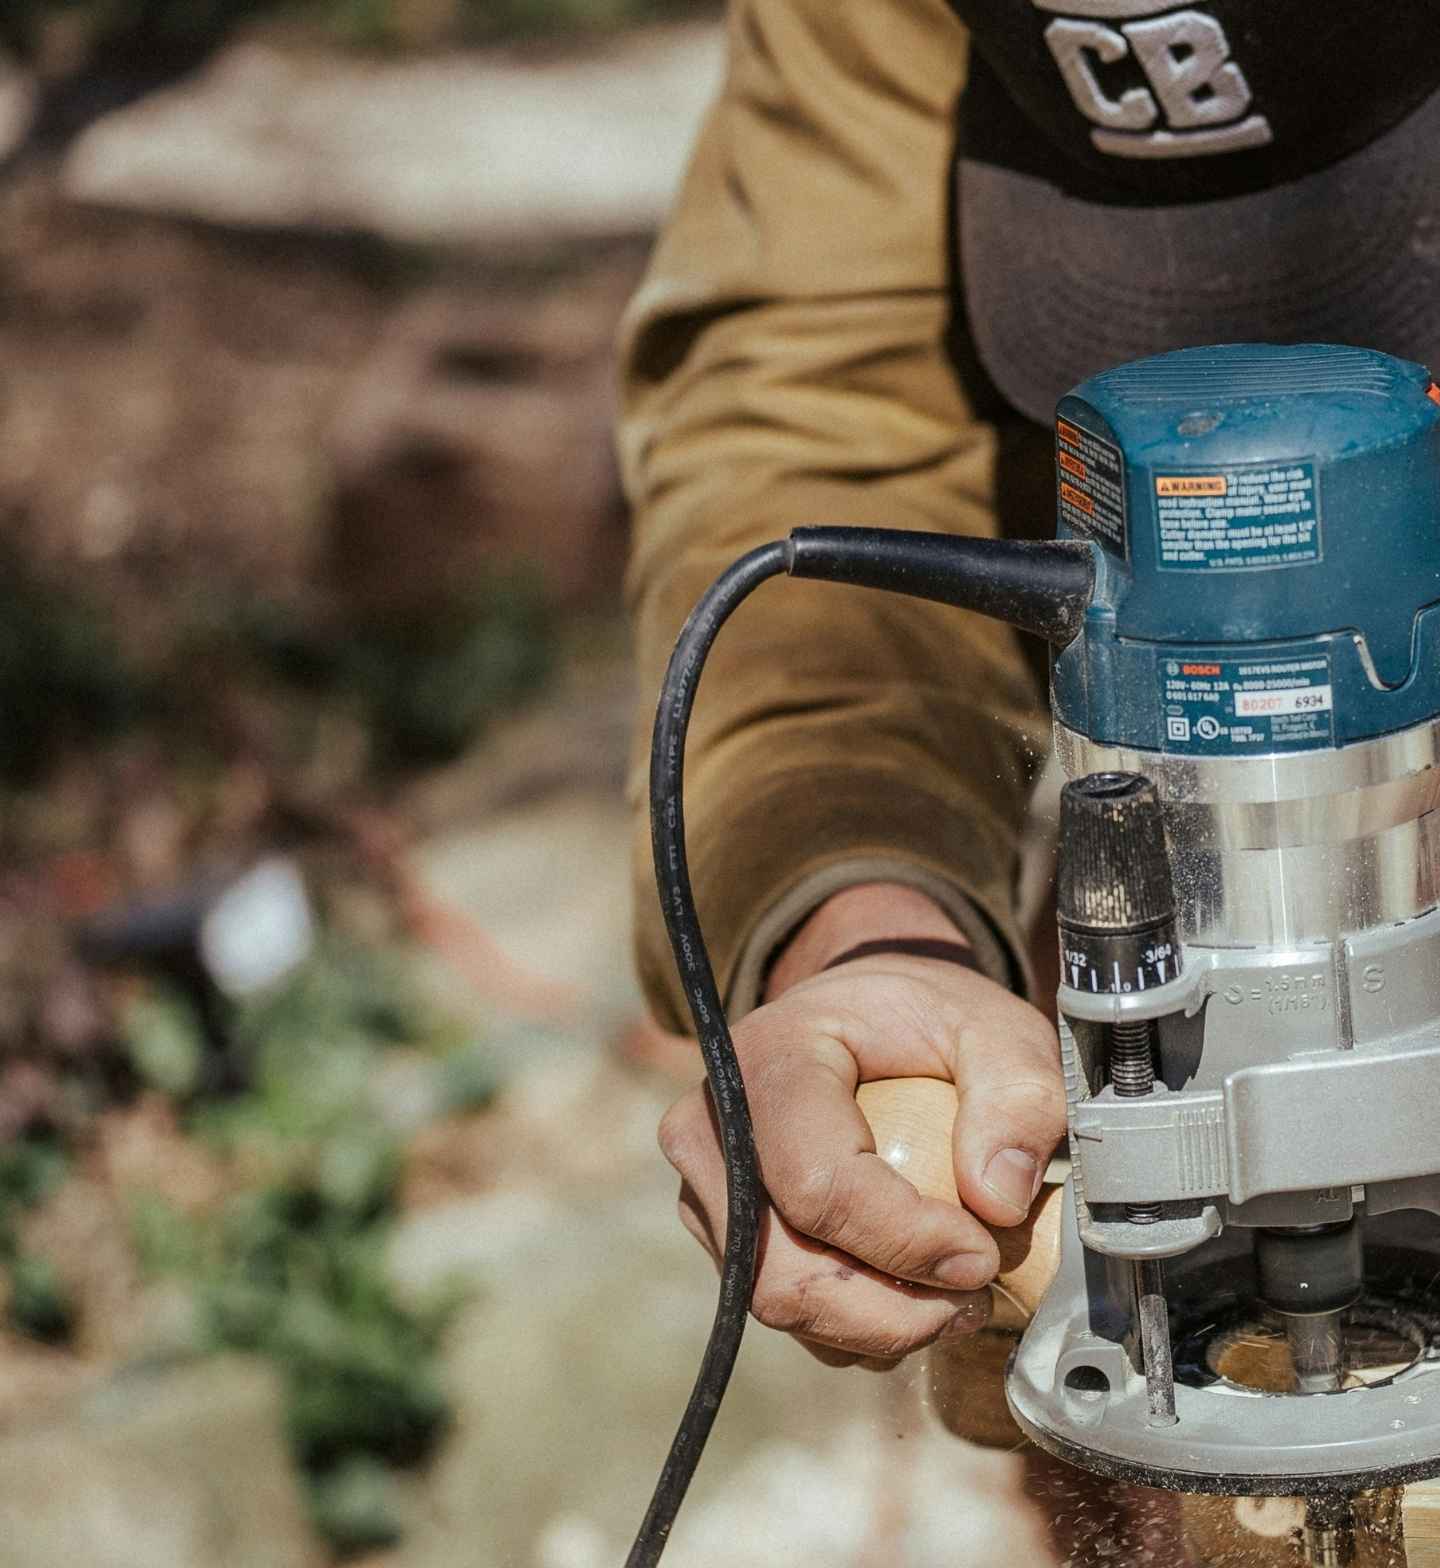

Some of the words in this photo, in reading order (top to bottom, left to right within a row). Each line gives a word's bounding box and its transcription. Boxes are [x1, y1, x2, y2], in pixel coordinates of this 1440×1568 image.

[1044, 9, 1251, 130] CB
[1171, 480, 1223, 492] WARNING
[1183, 664, 1220, 675] BOSCH
[1065, 949, 1087, 968] 1/32
